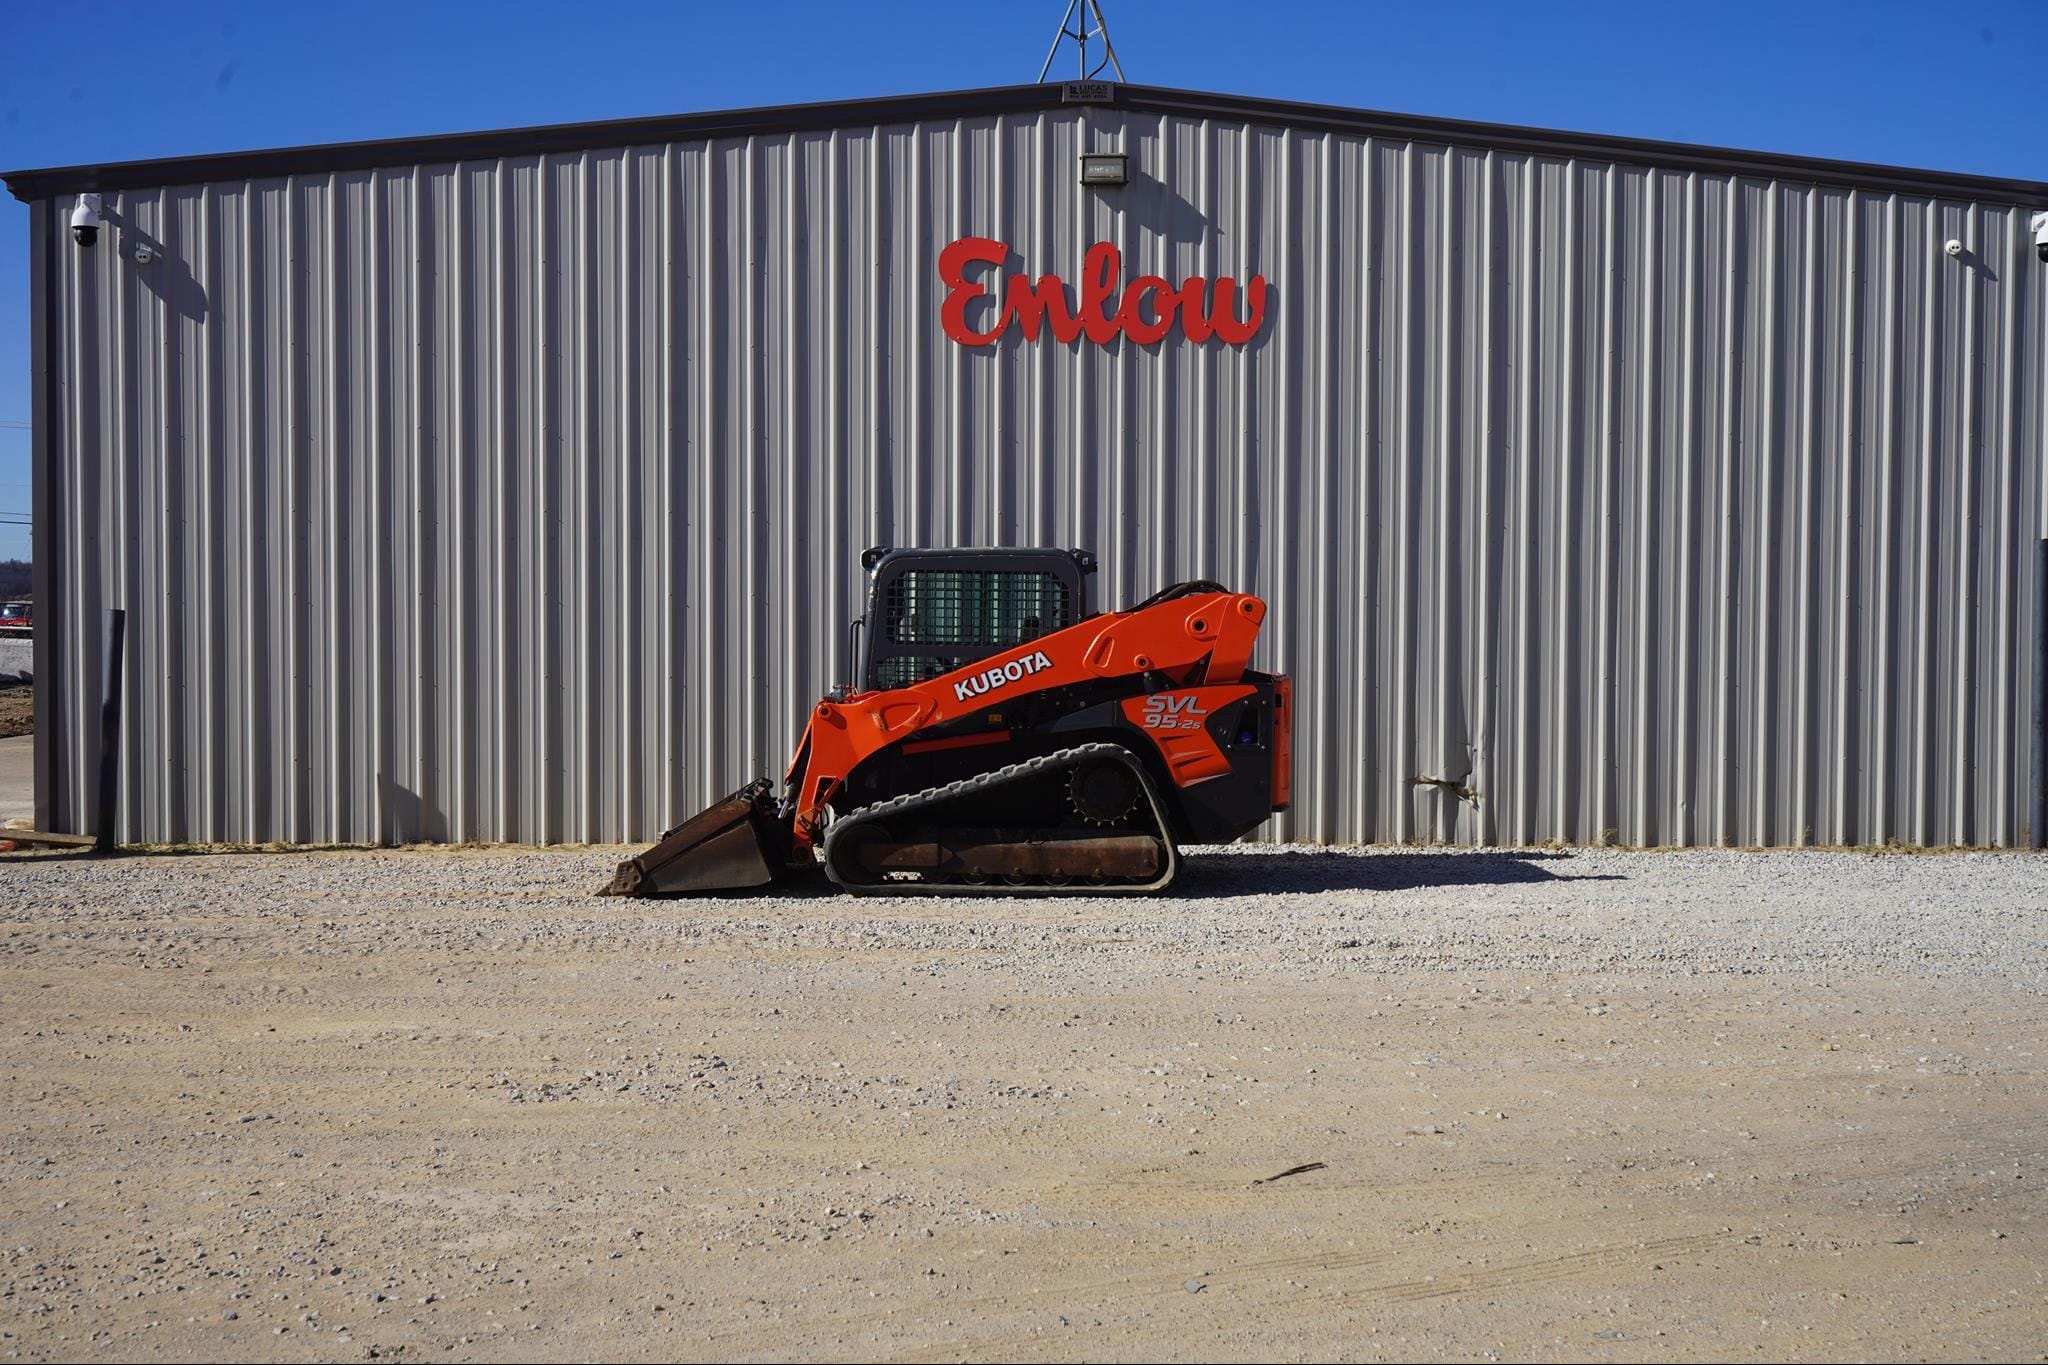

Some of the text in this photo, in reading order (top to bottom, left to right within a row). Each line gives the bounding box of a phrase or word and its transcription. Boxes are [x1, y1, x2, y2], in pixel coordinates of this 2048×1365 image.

[938, 237, 1266, 346] Enlow
[953, 651, 1053, 701] KUBOTA
[1142, 695, 1208, 714] SVL
